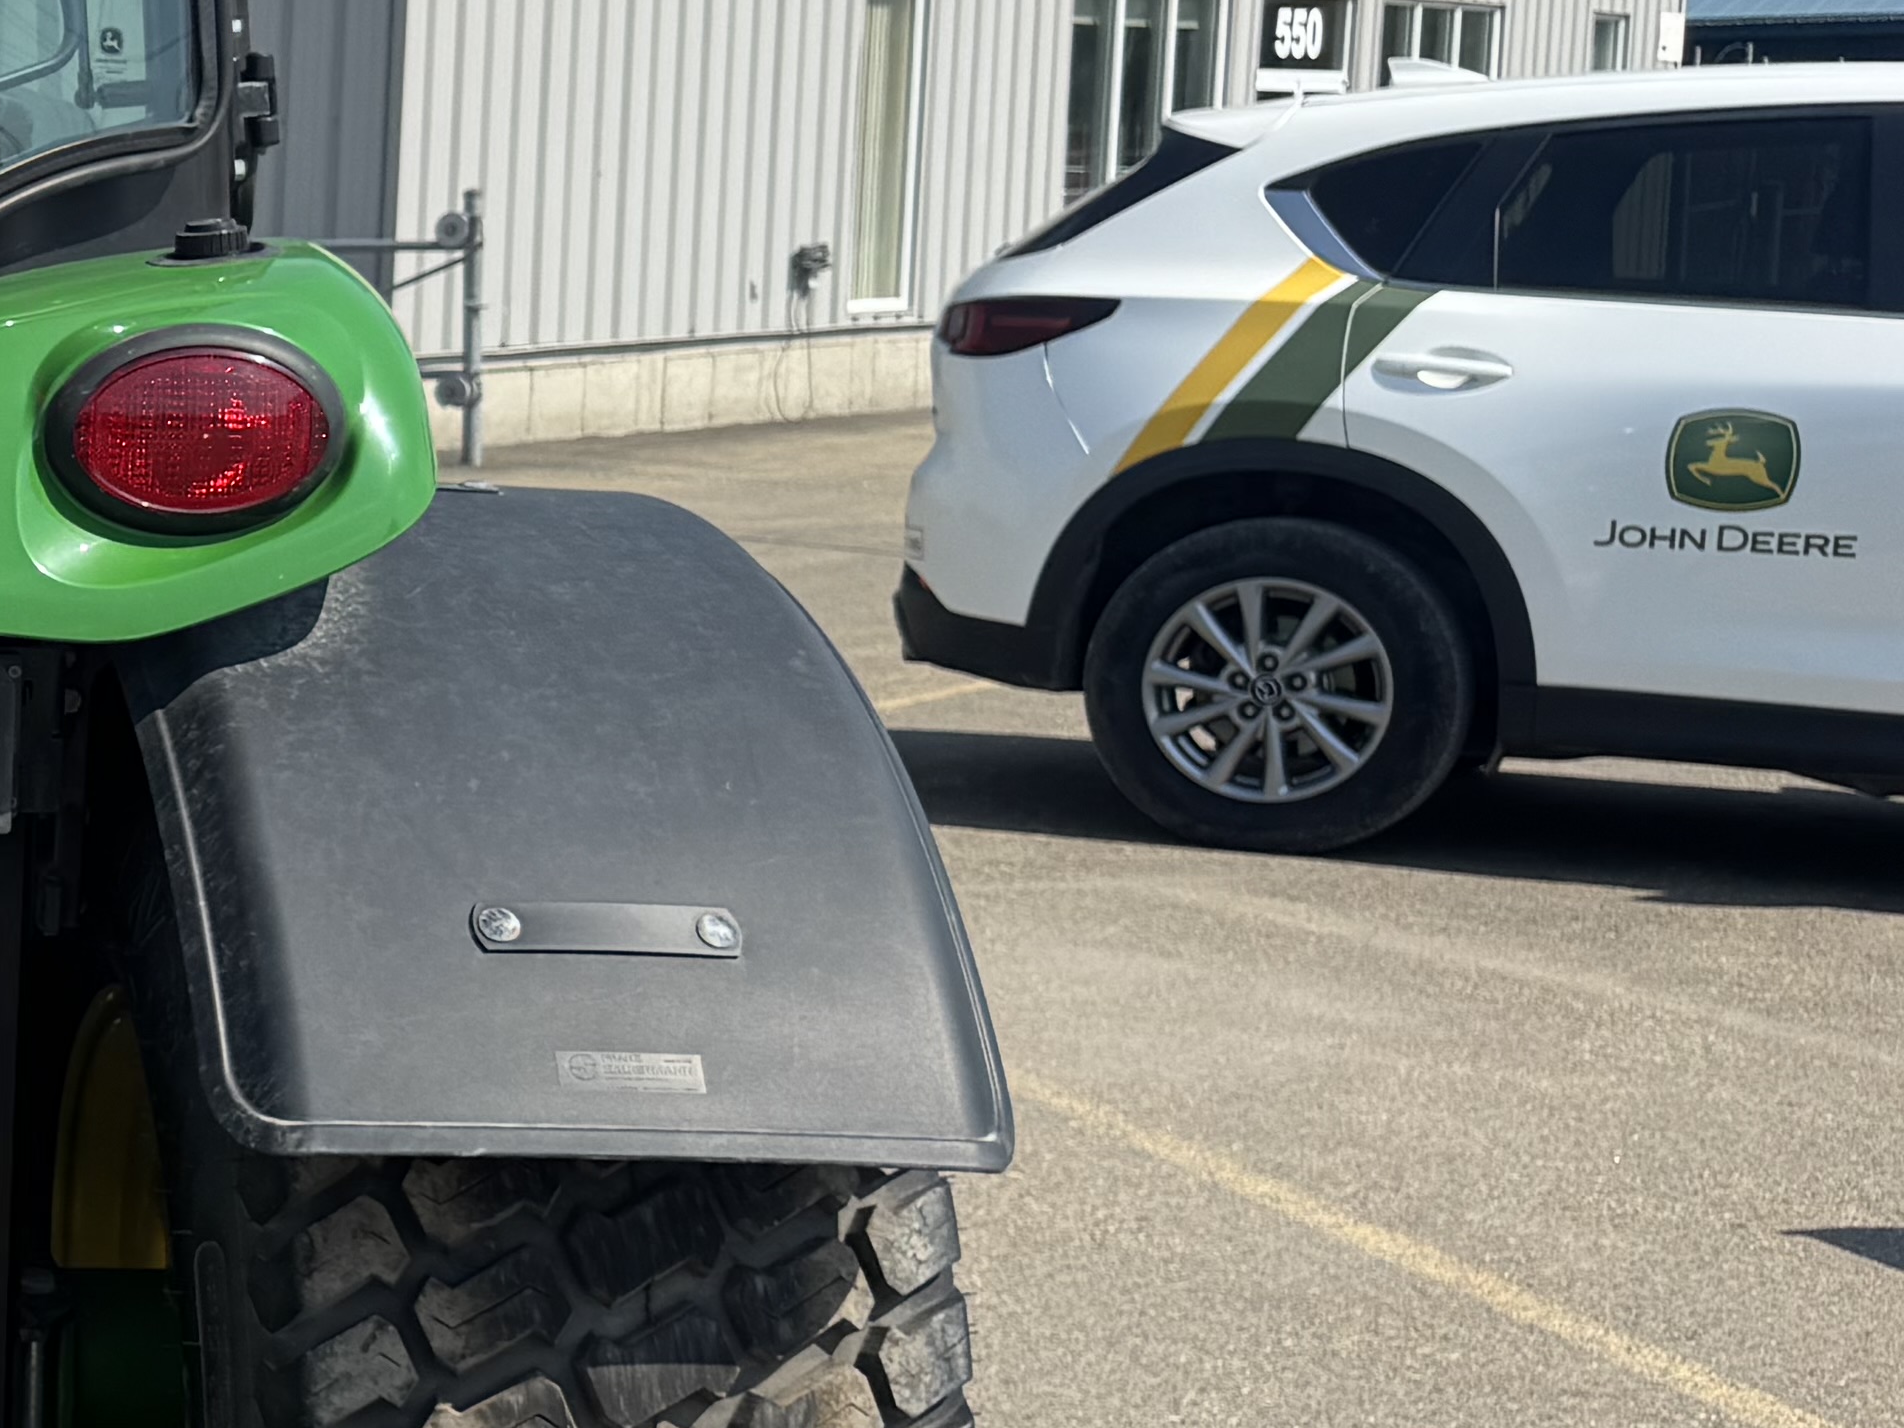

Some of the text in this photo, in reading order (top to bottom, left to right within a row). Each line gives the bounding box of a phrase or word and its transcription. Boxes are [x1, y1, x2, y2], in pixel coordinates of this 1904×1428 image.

[1274, 6, 1323, 60] 550
[1593, 519, 1858, 559] JOHN DEERE
